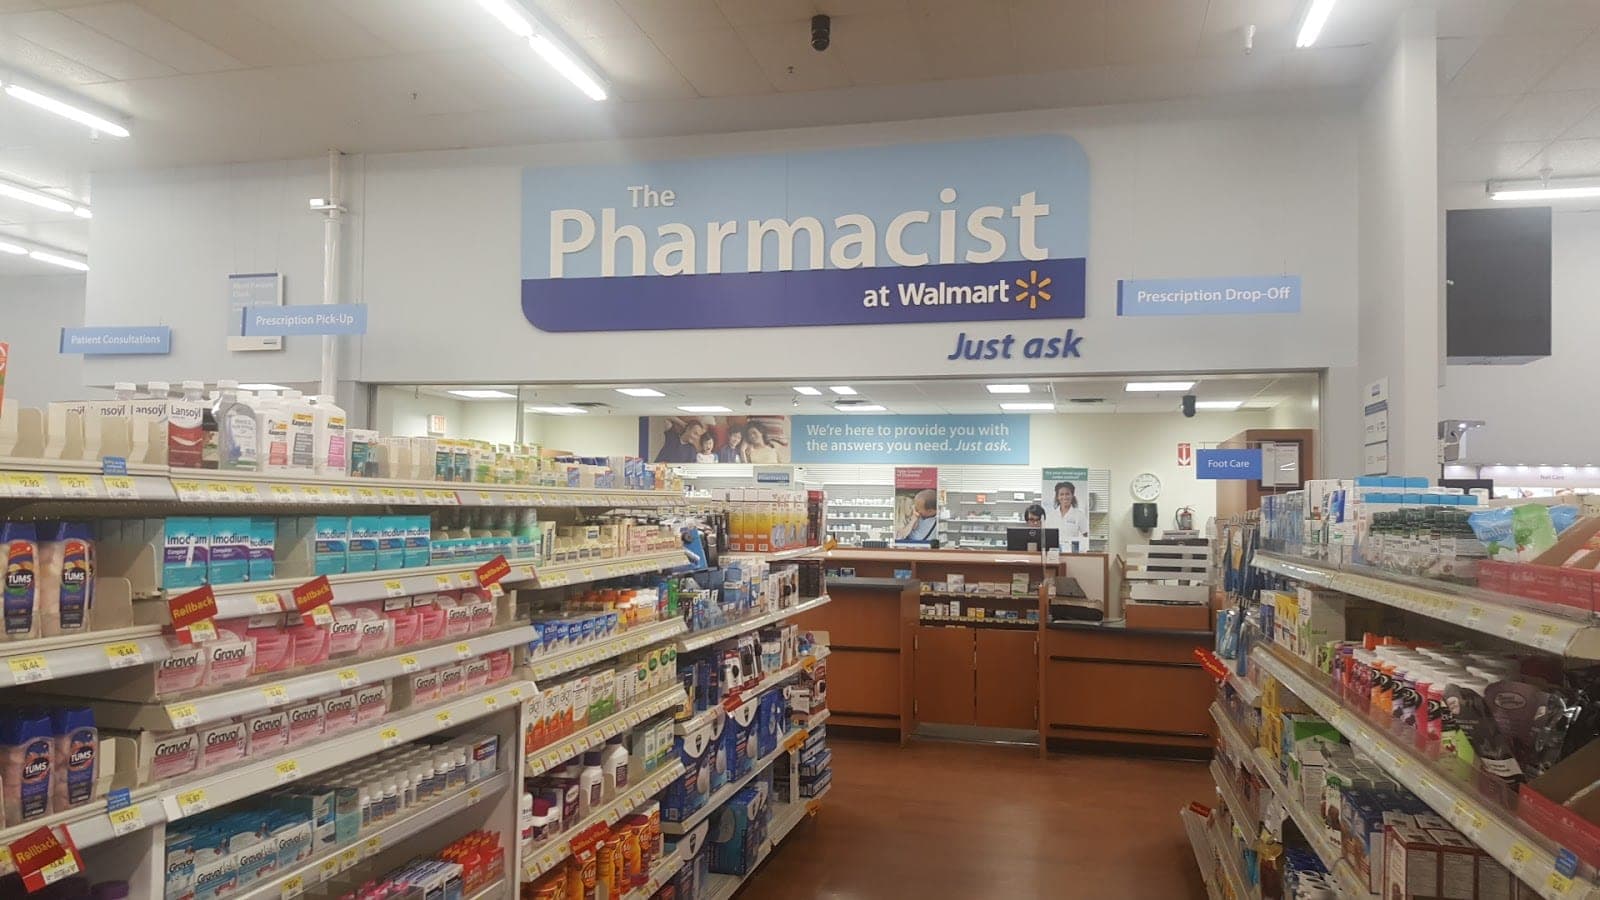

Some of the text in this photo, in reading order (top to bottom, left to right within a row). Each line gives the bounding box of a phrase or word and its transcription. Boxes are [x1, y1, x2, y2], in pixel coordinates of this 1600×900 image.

[627, 185, 675, 208] The
[549, 188, 1050, 279] Pharmacist
[863, 281, 1009, 308] at Walmart
[1137, 286, 1290, 304] Prescription Drop-Off
[256, 314, 354, 328] Prescription Pick-Up
[71, 334, 161, 345] Patient Consultations
[948, 330, 1082, 361] Just ask
[806, 423, 1009, 440] We're here to provide you with
[807, 440, 1011, 455] the answers you need. Just ask.
[1208, 459, 1250, 468] Foot Care
[213, 533, 249, 544] Imodium
[8, 574, 32, 584] TUMS
[64, 572, 85, 580] TUMS
[172, 596, 214, 619] Rollback
[213, 646, 246, 661] Gravol
[253, 716, 282, 732] Gravol
[207, 727, 240, 745] Gravol
[155, 737, 192, 756] Gravol
[71, 750, 92, 762] TUMS
[25, 761, 47, 775] TUMS
[15, 836, 58, 864] Rollback
